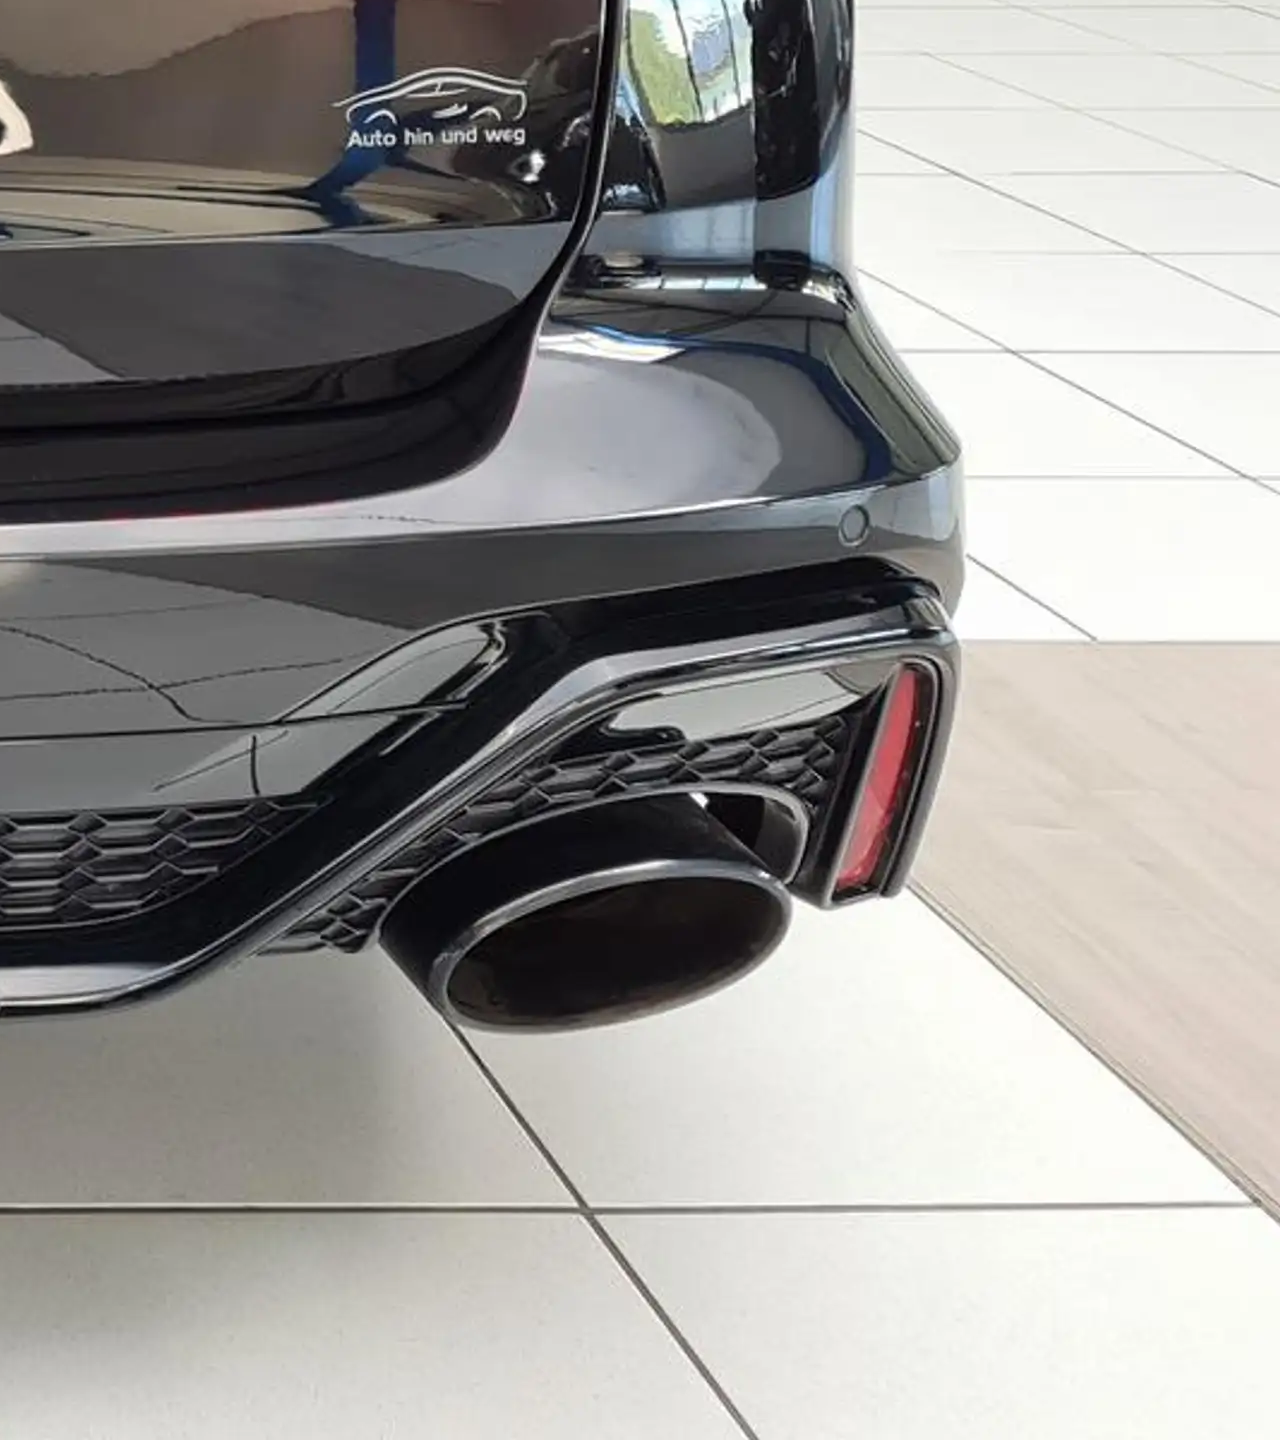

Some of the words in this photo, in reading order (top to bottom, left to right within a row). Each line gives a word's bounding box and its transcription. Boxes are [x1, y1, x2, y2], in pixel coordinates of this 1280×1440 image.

[347, 130, 397, 148] Auto
[404, 129, 434, 145] hin
[441, 127, 478, 144] und
[485, 128, 526, 145] weg
